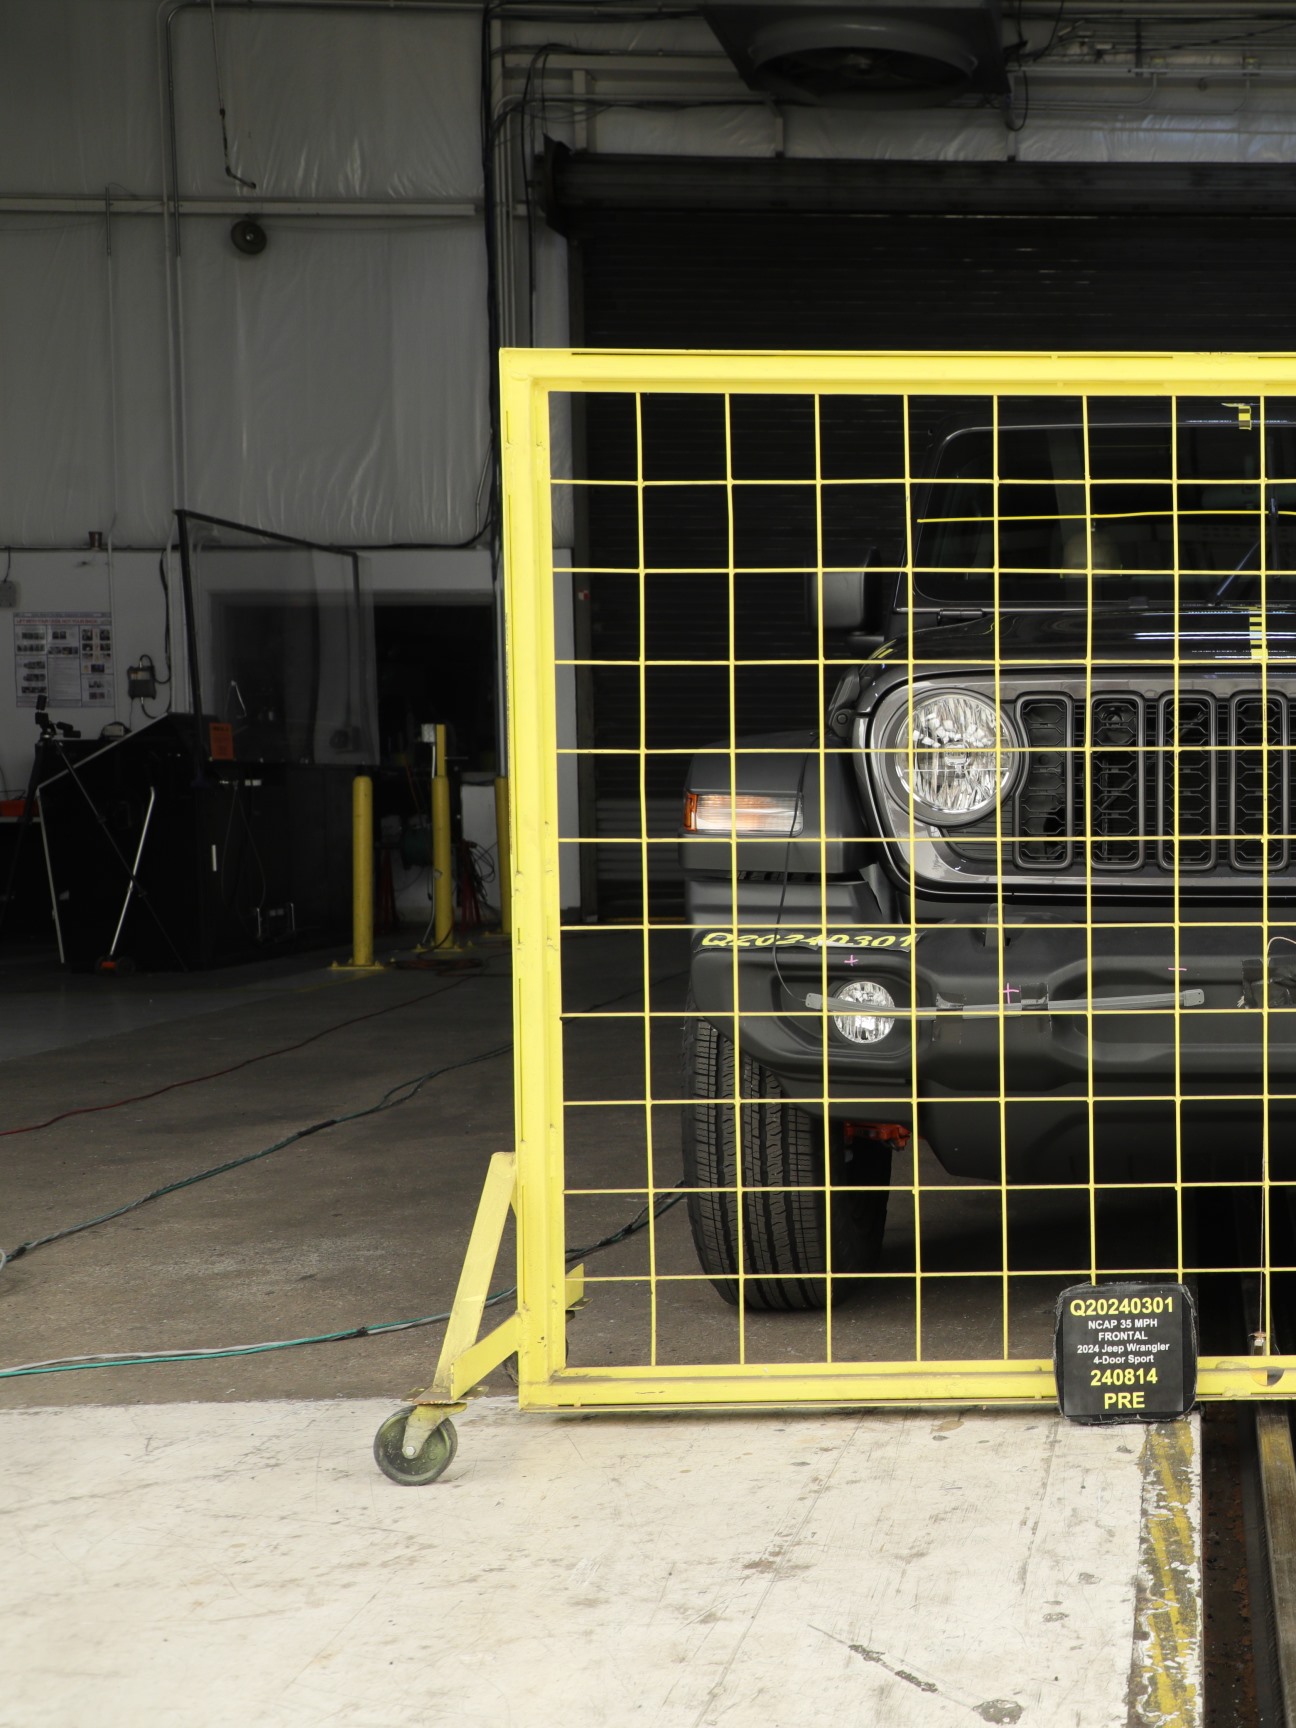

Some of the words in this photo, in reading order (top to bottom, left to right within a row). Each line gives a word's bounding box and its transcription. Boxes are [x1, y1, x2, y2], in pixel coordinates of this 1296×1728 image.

[701, 931, 917, 947] Q20240301
[1070, 1297, 1173, 1317] Q20240301
[1088, 1320, 1118, 1330] NCAP
[1120, 1319, 1132, 1329] 35
[1134, 1318, 1158, 1328] MPH
[1098, 1331, 1148, 1341] FRONTAL
[1077, 1344, 1099, 1354] 2024
[1102, 1344, 1125, 1354] Jeep
[1126, 1342, 1170, 1353] Wrangler
[1093, 1355, 1126, 1365] 4-Door
[1128, 1354, 1155, 1365] Sport
[1090, 1368, 1158, 1386] 240814
[1104, 1392, 1145, 1409] PRE
